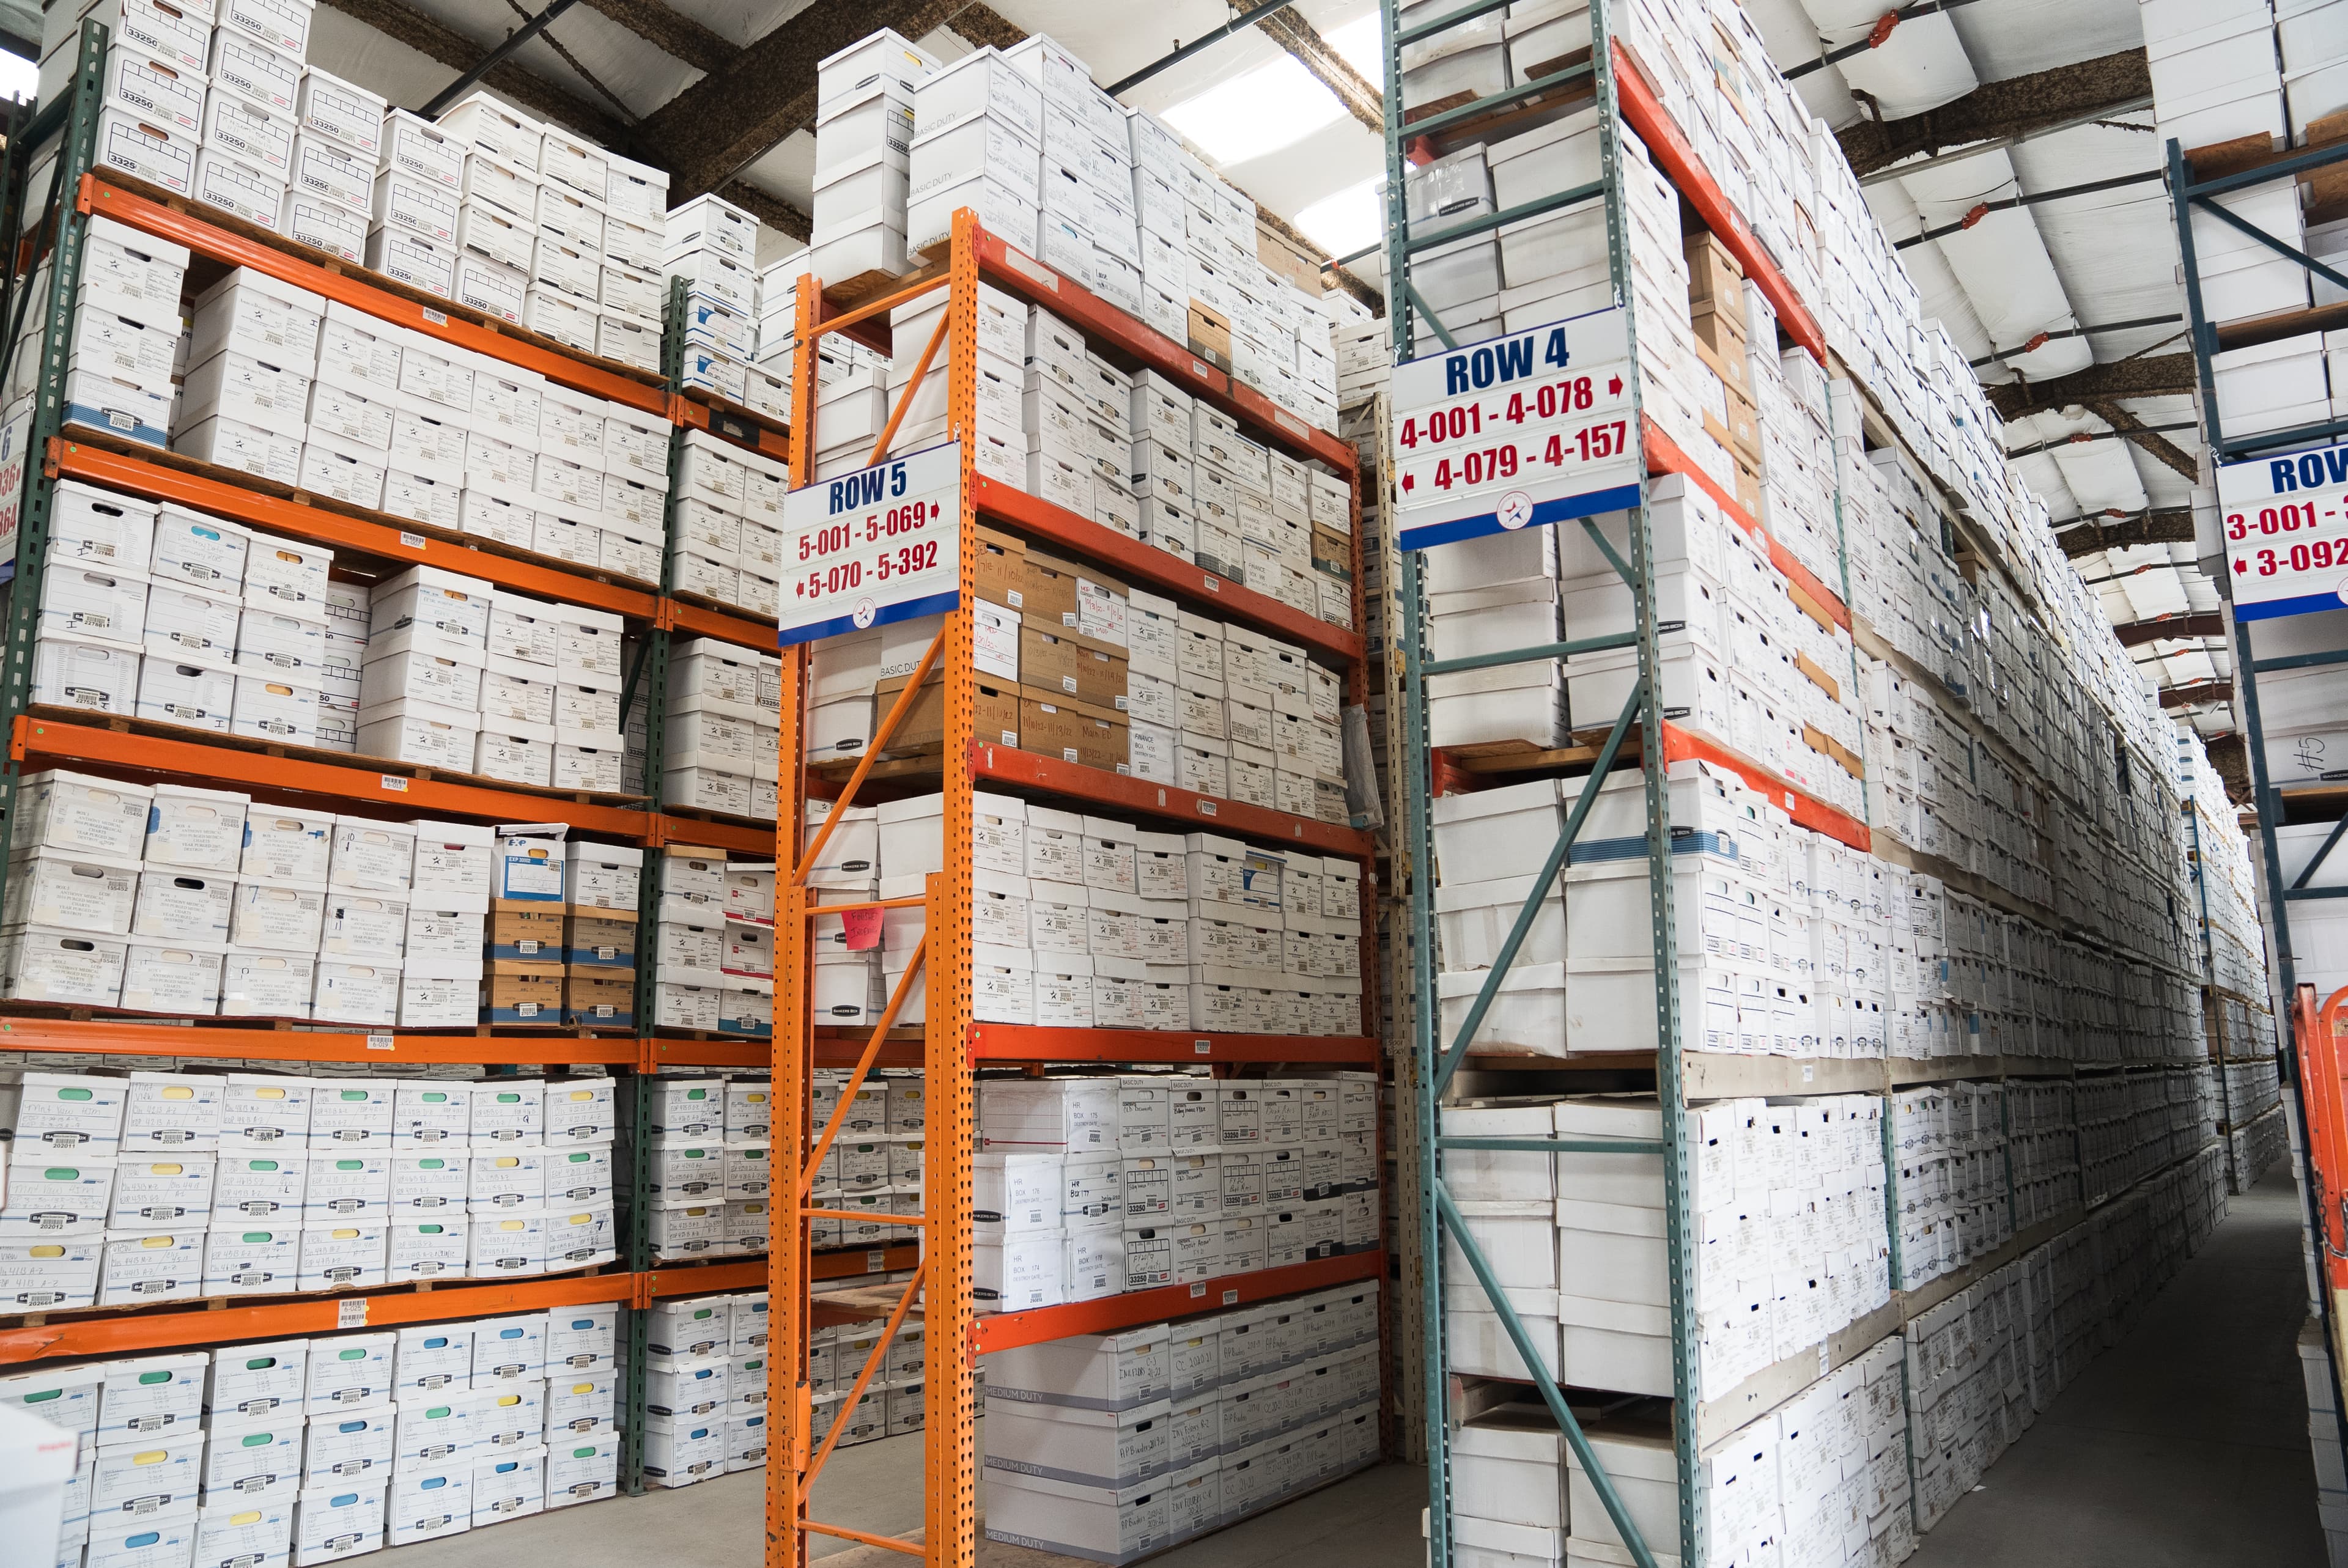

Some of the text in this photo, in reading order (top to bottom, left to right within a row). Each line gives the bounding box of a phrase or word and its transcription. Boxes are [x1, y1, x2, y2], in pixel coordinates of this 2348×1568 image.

[234, 13, 262, 31] 33250
[128, 28, 157, 47] 33250
[223, 72, 251, 89] 33250
[122, 91, 153, 109] 33250
[313, 118, 339, 134] 33250
[915, 112, 956, 139] BASIC DUTY
[218, 131, 245, 149] 33250
[888, 138, 908, 154] 33250
[110, 154, 137, 170] 3325
[399, 156, 423, 170] 33250
[304, 176, 329, 191] 33250
[910, 172, 953, 196] BASIC DUTY
[206, 191, 234, 212] 33250
[394, 212, 417, 226] 33250
[295, 234, 322, 247] 33250
[907, 230, 950, 257] BASIC DUTY
[464, 296, 487, 309] 33250
[1445, 327, 1570, 396] ROW 4
[1400, 402, 1480, 449] 4-001
[1506, 376, 1593, 424] 4-078
[2, 426, 12, 462] 6
[1434, 444, 1518, 490] 4-079
[1544, 420, 1626, 467] 4-157
[0, 463, 16, 497] 36
[829, 462, 906, 515] ROW 5
[2226, 501, 2317, 540] 3-001
[799, 523, 850, 561] 5-001
[866, 501, 926, 542] 5-069
[2258, 538, 2348, 576] 3-092
[809, 561, 862, 598] 5-070
[878, 540, 937, 581] 5-392
[880, 660, 921, 676] BASIC DUT
[762, 699, 780, 707] 33250
[1129, 1275, 1146, 1283] 33250
[986, 1386, 1043, 1402] MEDIUM DUTY
[985, 1457, 1043, 1474] MEDIUM DUTY
[135, 1507, 158, 1515] 229635
[986, 1530, 1044, 1549] MEDIUM DUTY
